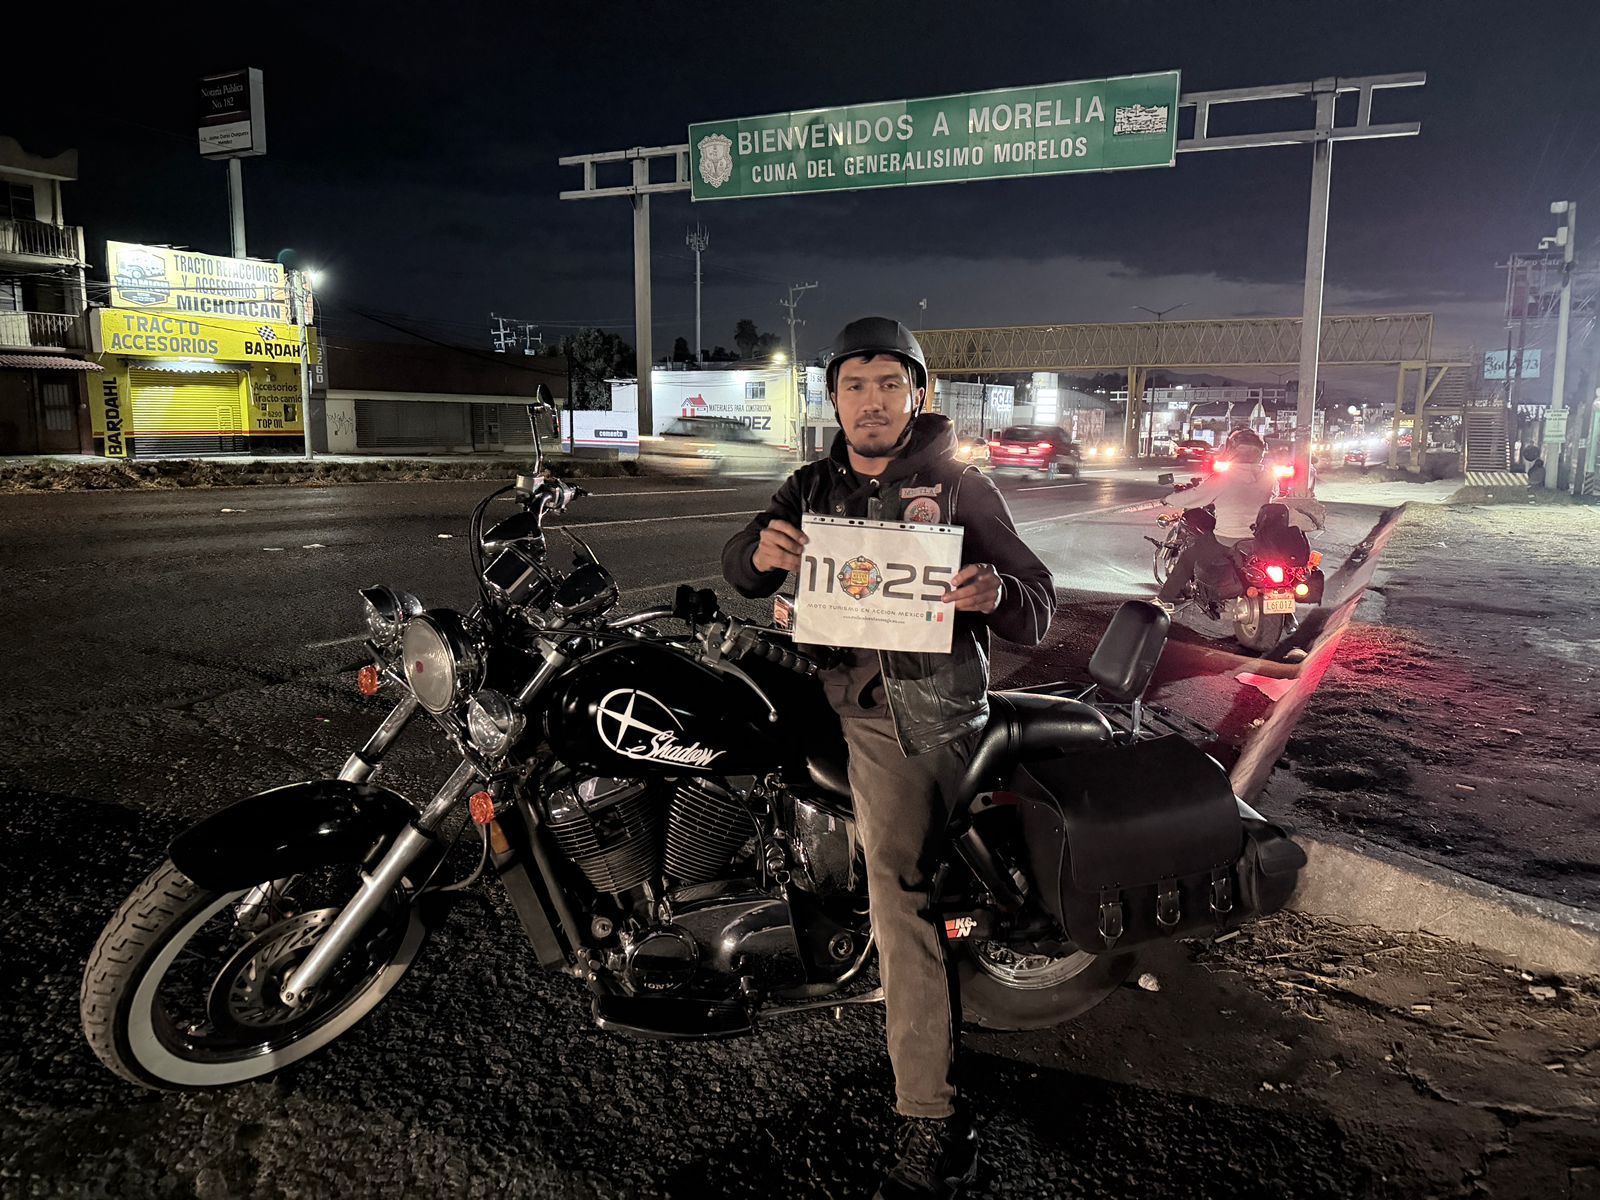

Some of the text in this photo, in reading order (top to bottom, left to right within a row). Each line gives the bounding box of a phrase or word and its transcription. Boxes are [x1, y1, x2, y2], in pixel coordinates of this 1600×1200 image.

[738, 114, 913, 155] BIENVENIDOS
[932, 111, 950, 137] A
[968, 95, 1105, 134] MORELIA
[752, 137, 1088, 183] CUNA DEL GENERALISIMO MORELOS
[174, 254, 214, 276] TRACTO
[181, 274, 188, 291] Y
[195, 277, 258, 299] ACCESORIOS
[176, 294, 281, 319] MICHOACAN
[122, 315, 200, 335] TRACTO
[111, 333, 218, 354] ACCESORIOS
[245, 341, 301, 359] BARDAH
[253, 381, 298, 392] Accesorios
[102, 377, 123, 455] BARDAHL
[709, 404, 733, 412] MATERIALES
[256, 418, 272, 429] TOP
[828, 604, 859, 612] TURISMO
[650, 730, 727, 766] Shadow
